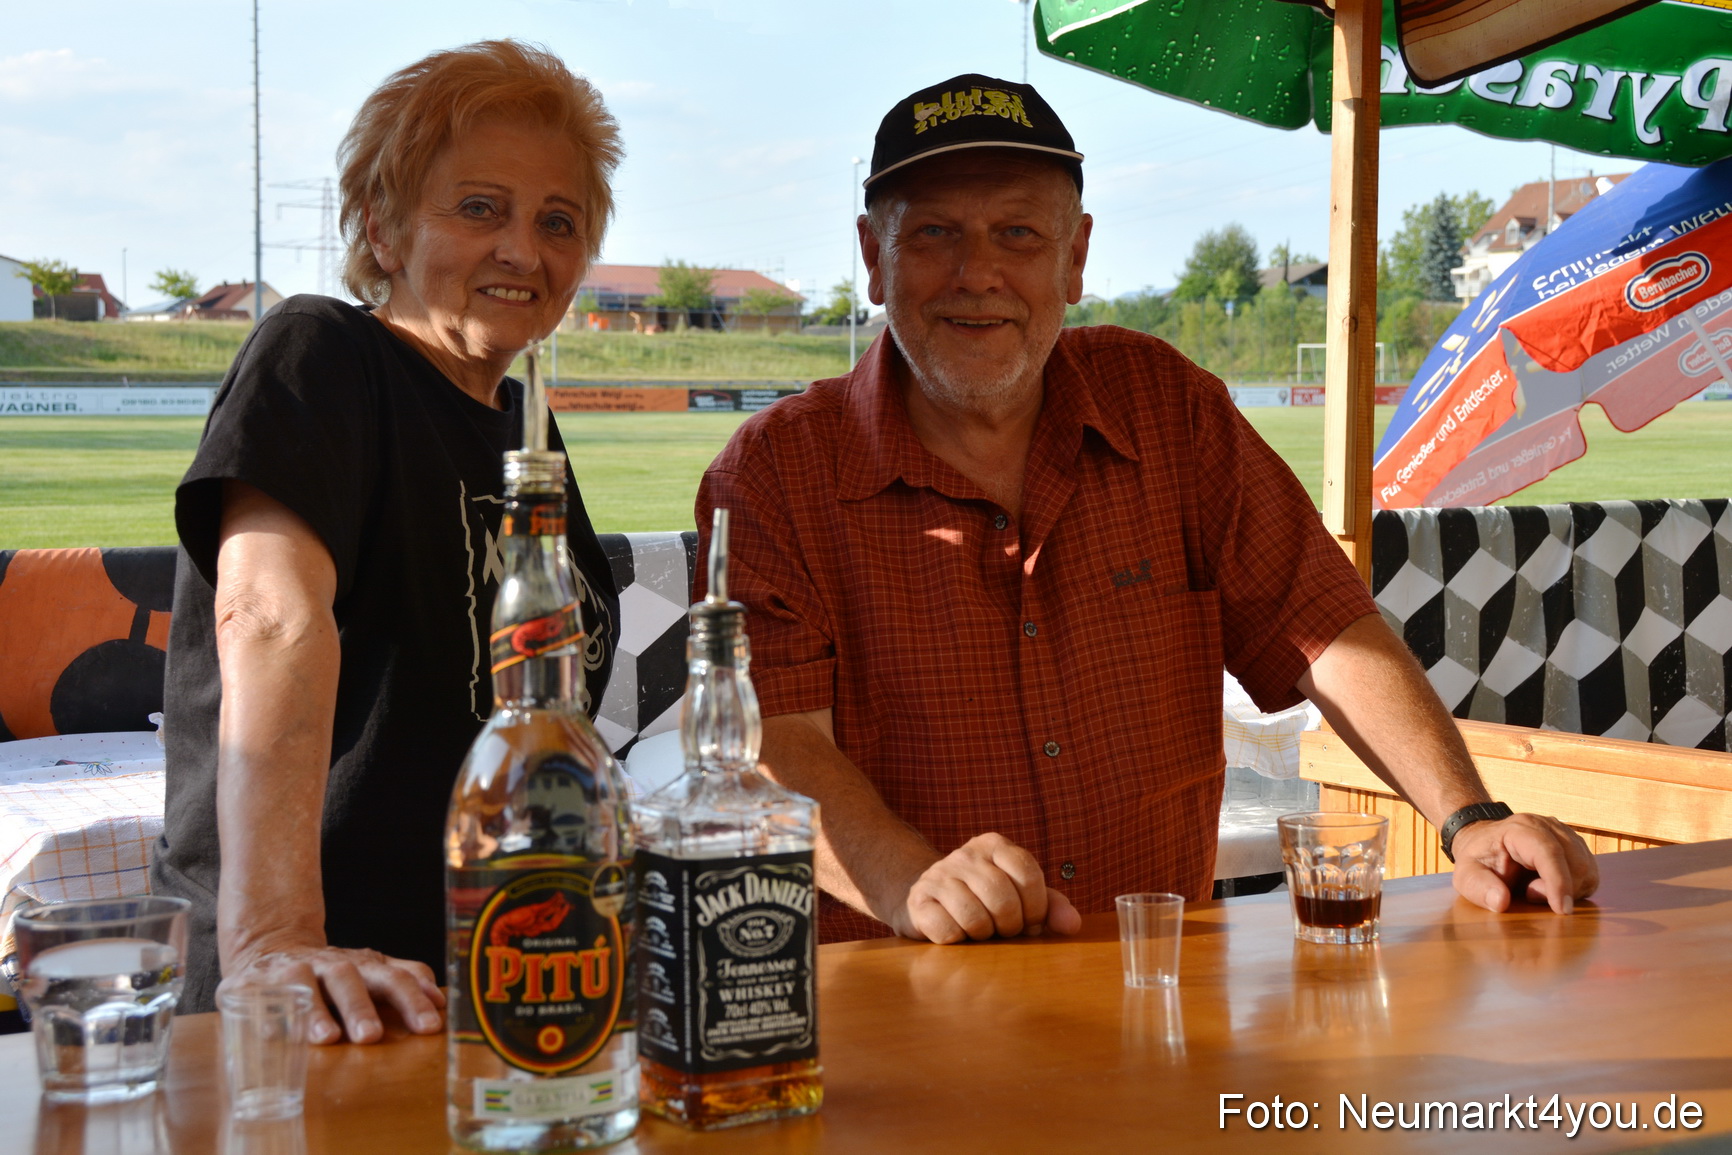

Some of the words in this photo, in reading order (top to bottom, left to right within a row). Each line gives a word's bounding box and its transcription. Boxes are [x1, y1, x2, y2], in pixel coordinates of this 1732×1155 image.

[1637, 263, 1700, 301] Bernbacher
[0, 402, 83, 412] AGNER.
[1453, 369, 1508, 422] Entdecker.
[695, 882, 746, 927] JACK
[744, 872, 815, 917] DANIEL'S
[485, 935, 611, 1003] PITÚ
[716, 958, 797, 979] Tennessee
[718, 981, 796, 1002] WHISKEY
